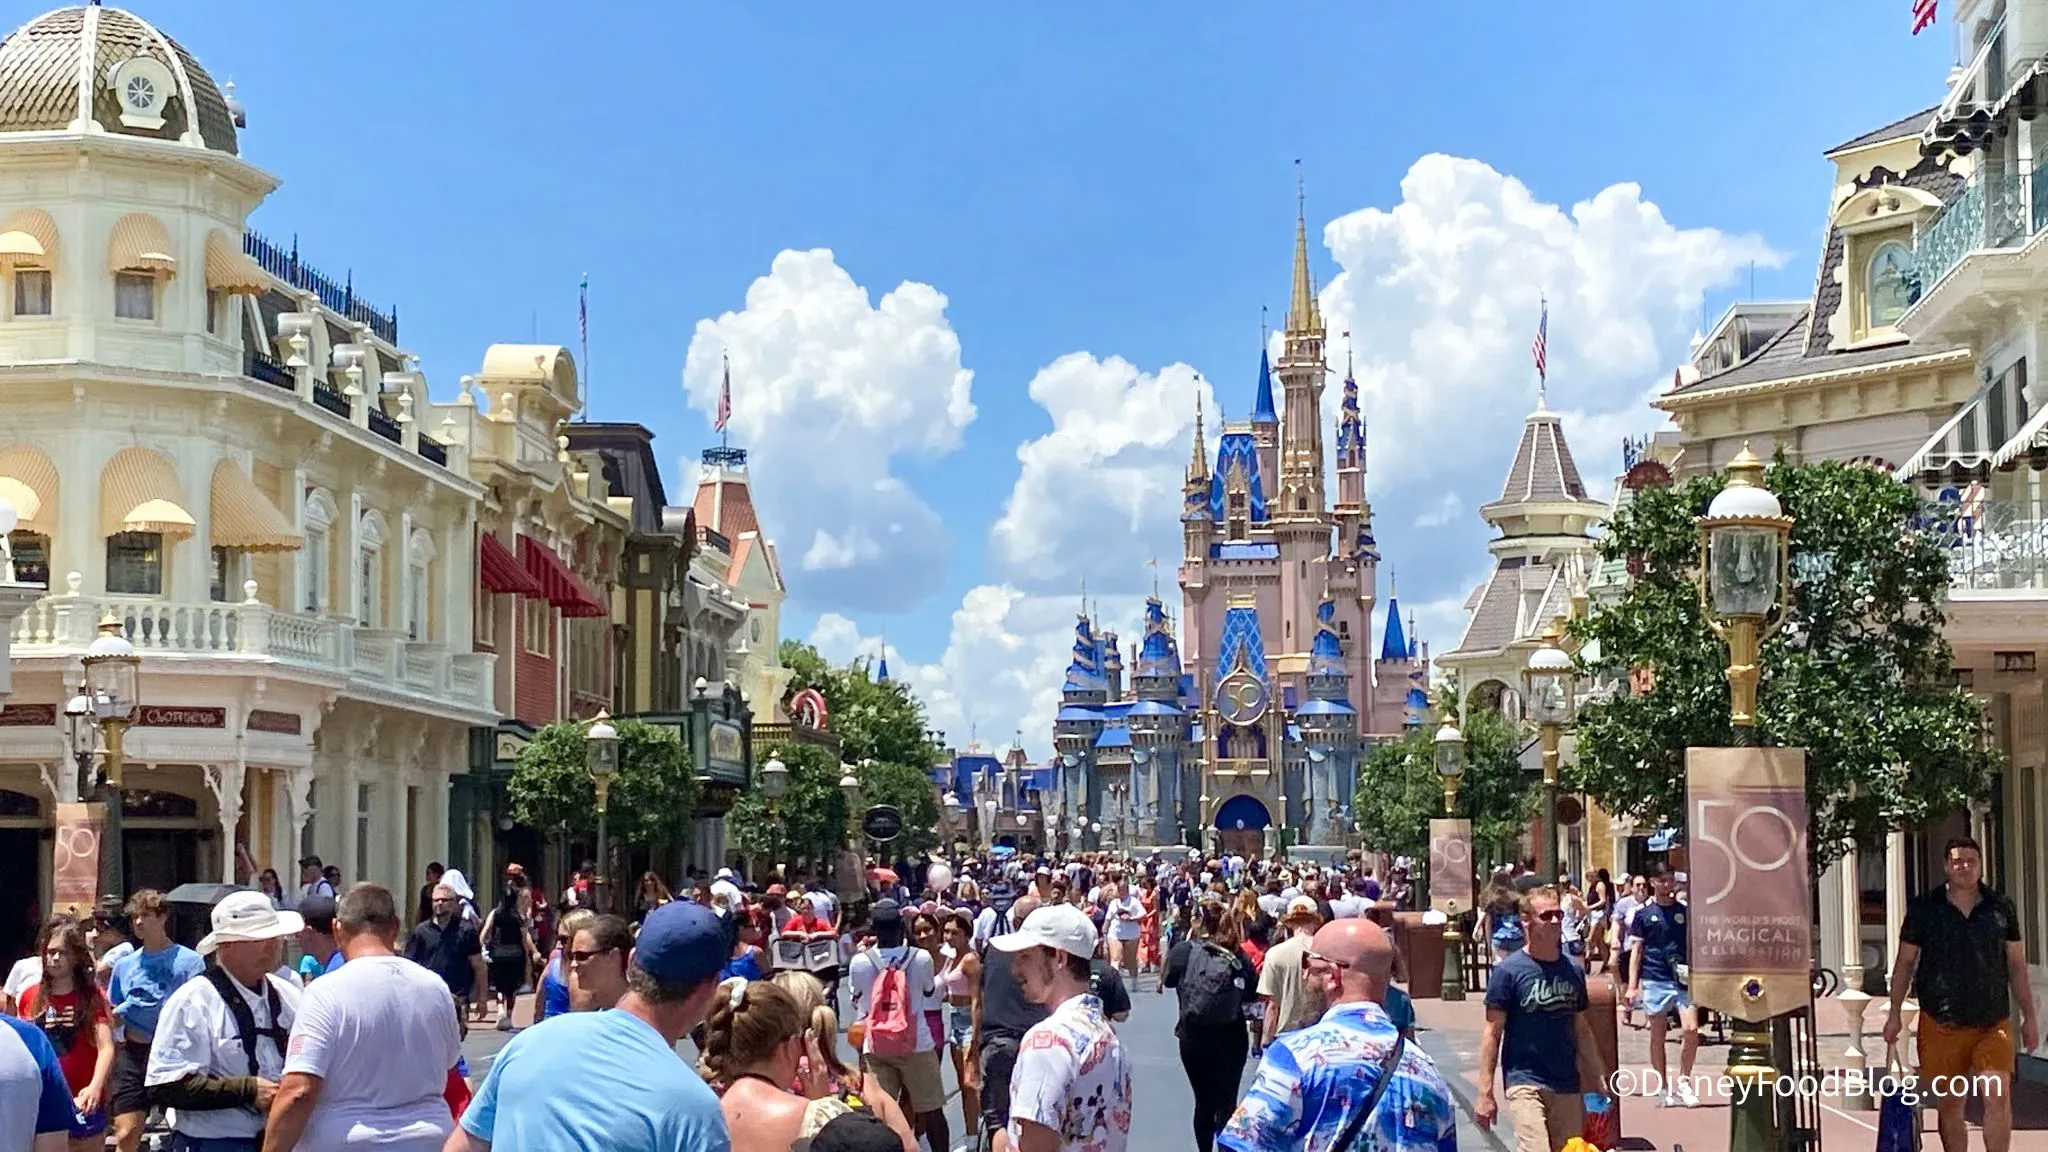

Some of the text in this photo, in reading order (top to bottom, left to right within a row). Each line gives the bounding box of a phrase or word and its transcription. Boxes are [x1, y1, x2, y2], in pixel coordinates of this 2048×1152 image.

[1227, 681, 1261, 719] 50
[58, 825, 97, 873] 50
[1432, 836, 1468, 874] 50
[1697, 799, 1798, 905] 50
[1700, 915, 1801, 926] THE WORLD'S MOST
[1706, 927, 1796, 943] MAGICAL
[1700, 945, 1801, 961] CELEBRATION
